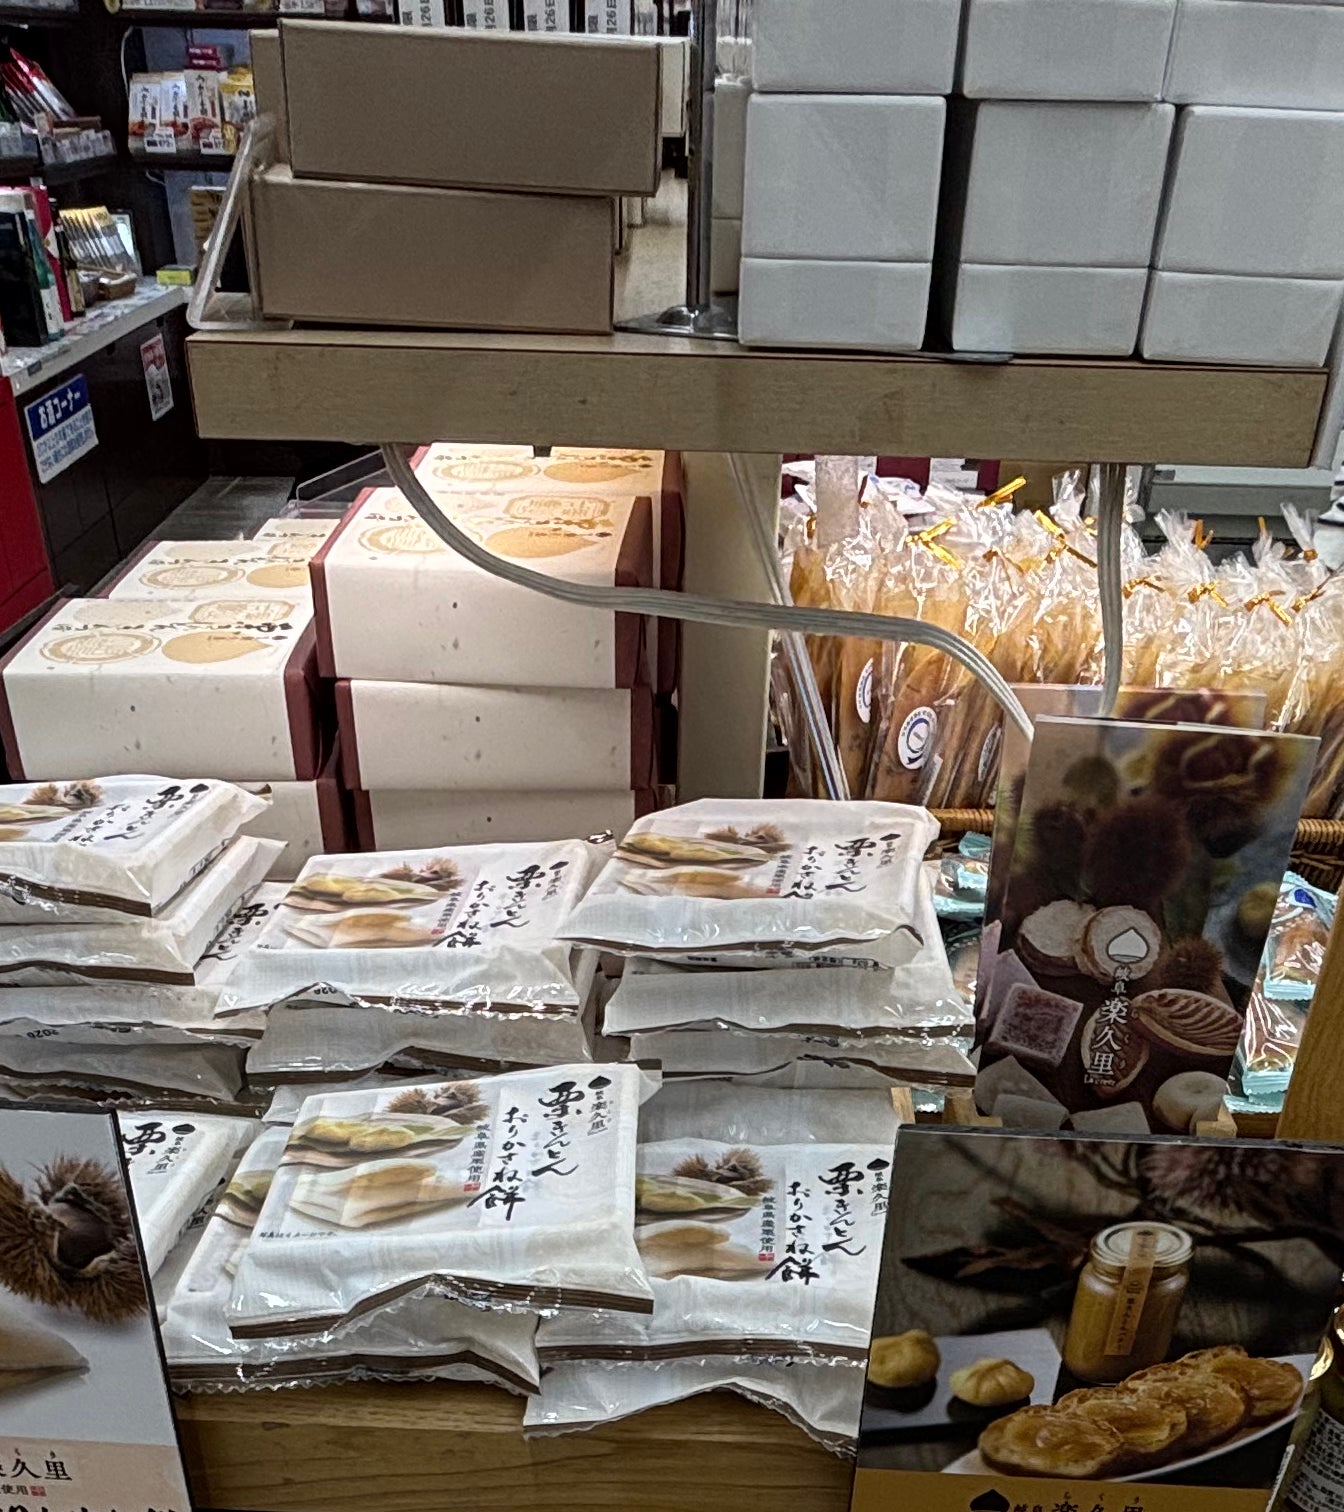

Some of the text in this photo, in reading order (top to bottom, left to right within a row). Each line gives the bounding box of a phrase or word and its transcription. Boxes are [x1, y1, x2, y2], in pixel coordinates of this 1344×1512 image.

[490, 864, 546, 928] 栗きんとん
[824, 837, 877, 893] 栗きんとん
[467, 1106, 530, 1222] おりかさね餅
[531, 1081, 586, 1178] 栗きんとん
[765, 1181, 821, 1286] おりかさね餅
[818, 1161, 867, 1257] 栗きんとん
